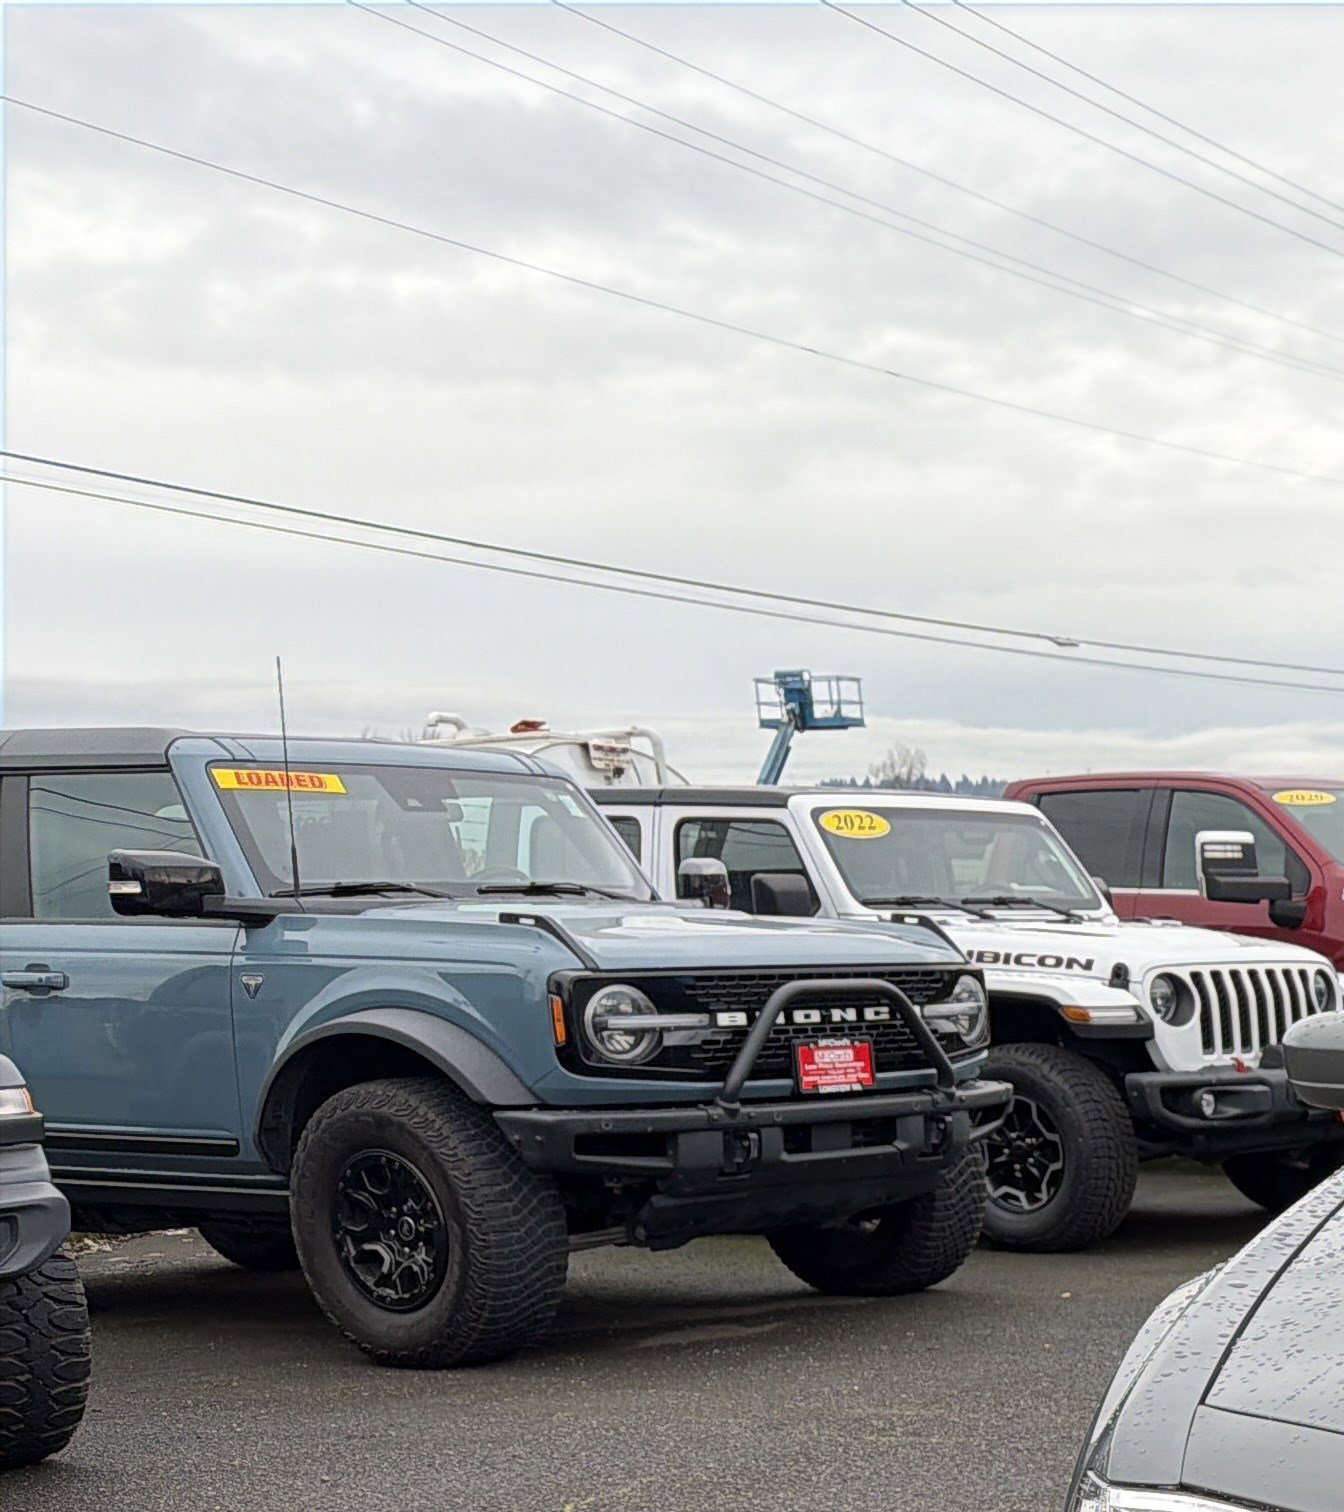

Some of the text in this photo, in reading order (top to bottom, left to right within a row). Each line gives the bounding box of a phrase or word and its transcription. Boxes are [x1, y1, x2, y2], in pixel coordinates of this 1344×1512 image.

[234, 771, 327, 789] LOADED
[832, 814, 877, 831] 2022
[966, 949, 1095, 971] BICON
